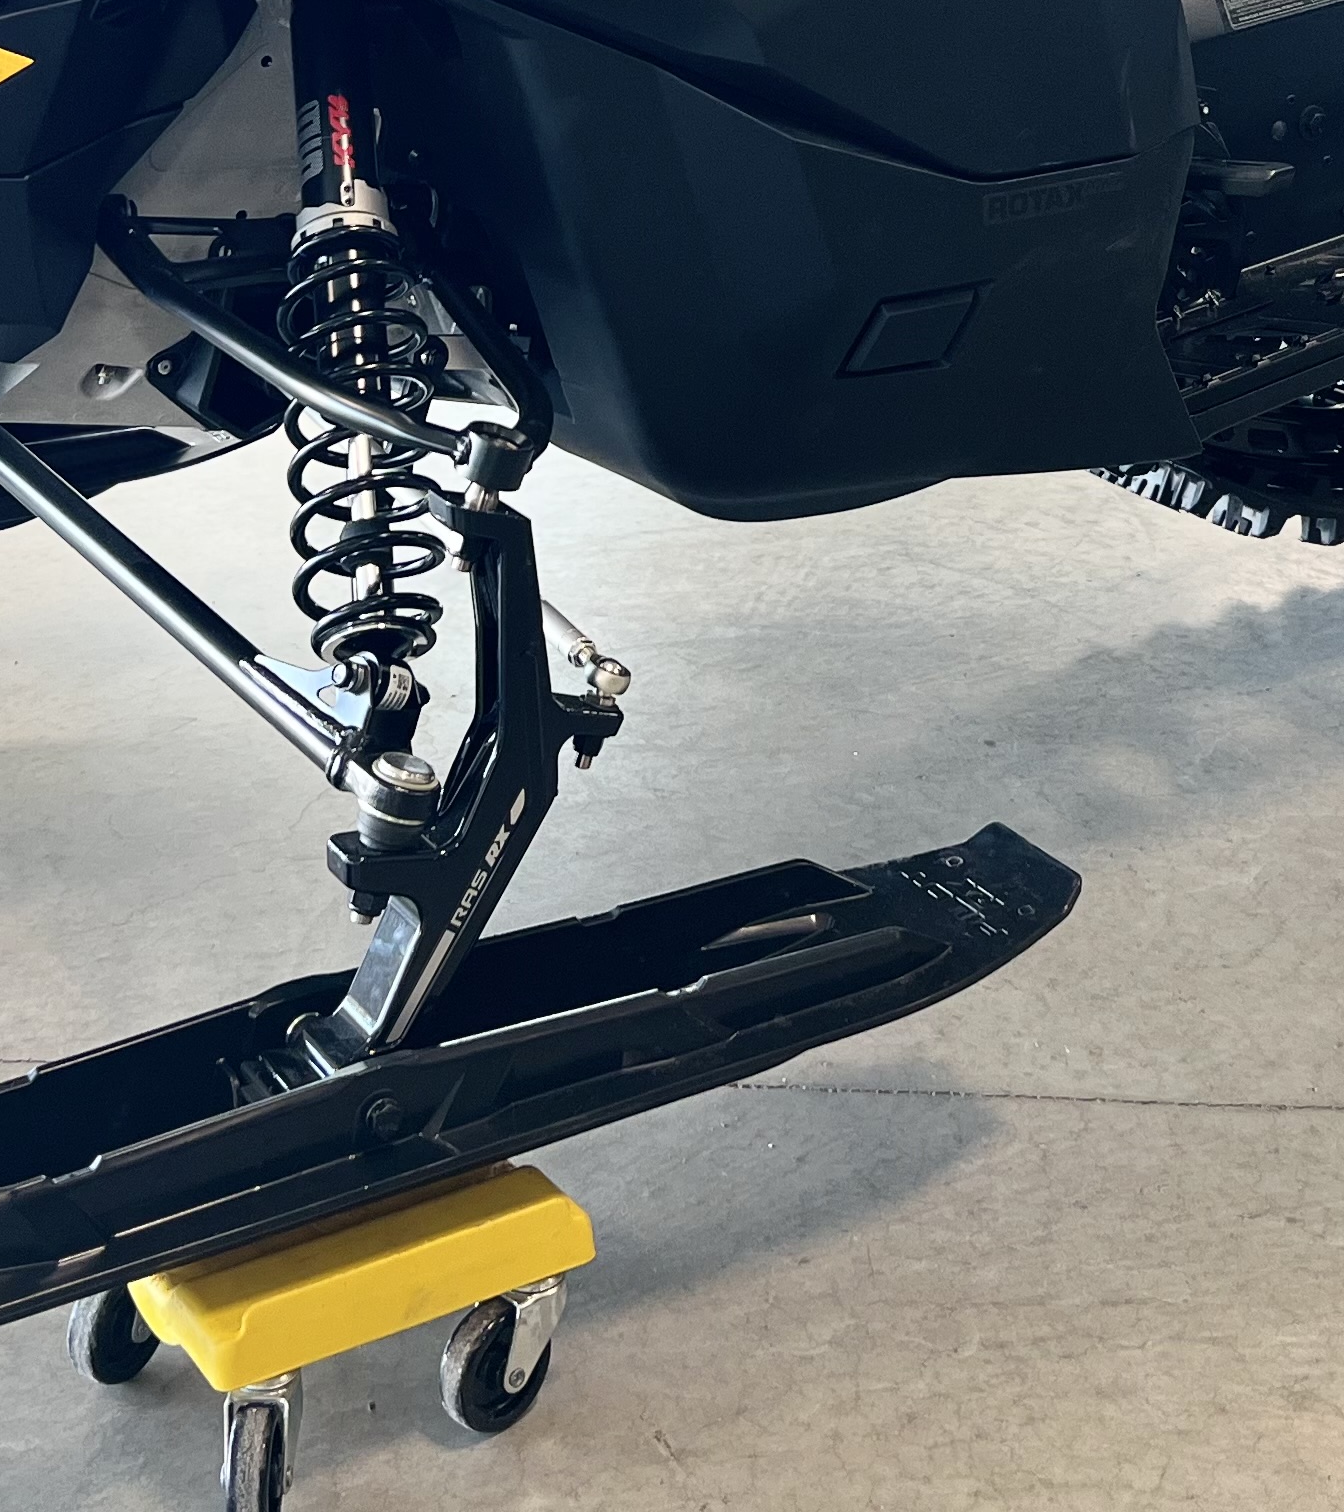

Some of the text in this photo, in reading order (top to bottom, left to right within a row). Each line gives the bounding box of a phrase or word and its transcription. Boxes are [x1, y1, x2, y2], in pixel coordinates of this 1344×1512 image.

[986, 184, 1086, 221] ROTAX
[450, 823, 511, 928] RAS RX
